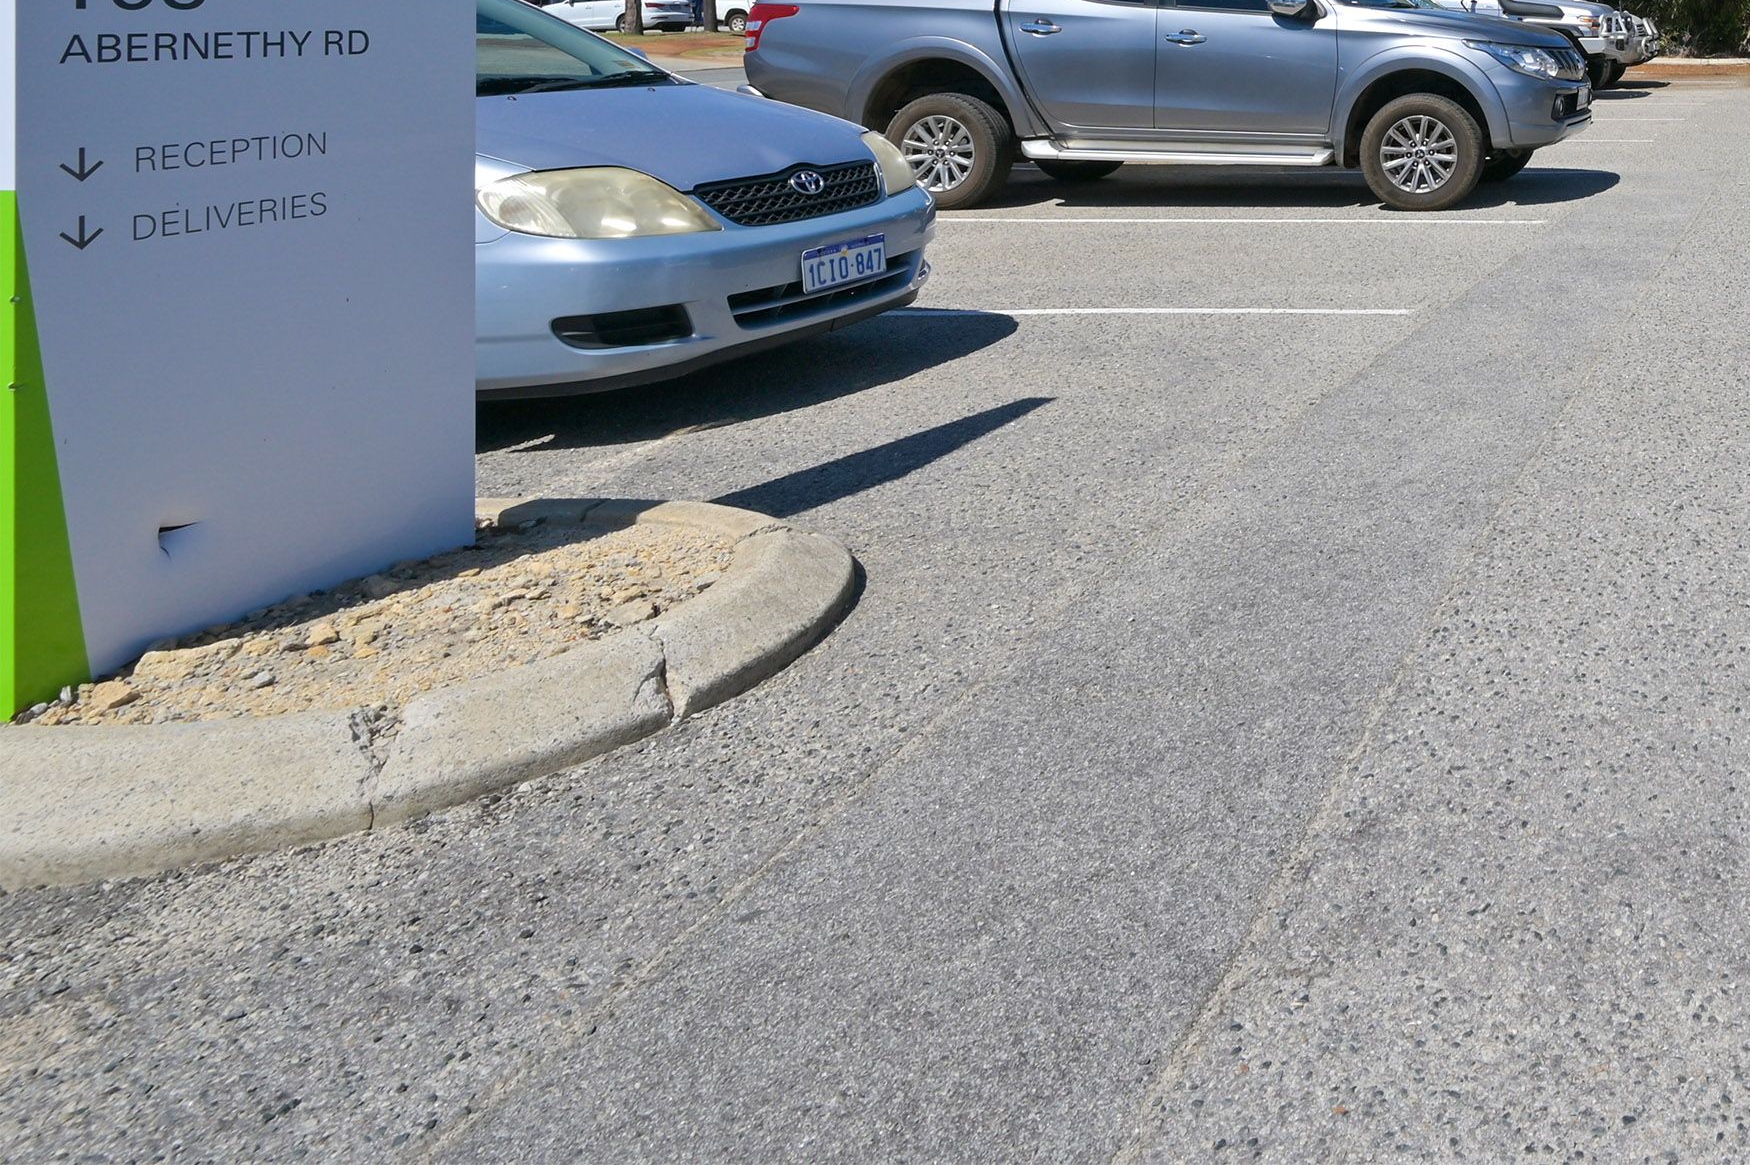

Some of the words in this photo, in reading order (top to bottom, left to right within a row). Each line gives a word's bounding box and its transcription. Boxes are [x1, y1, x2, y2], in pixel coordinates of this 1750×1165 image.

[59, 30, 312, 66] ABERNETHY
[323, 29, 371, 57] RD
[135, 131, 328, 174] RECEPTION
[132, 191, 328, 242] DELIVERIES
